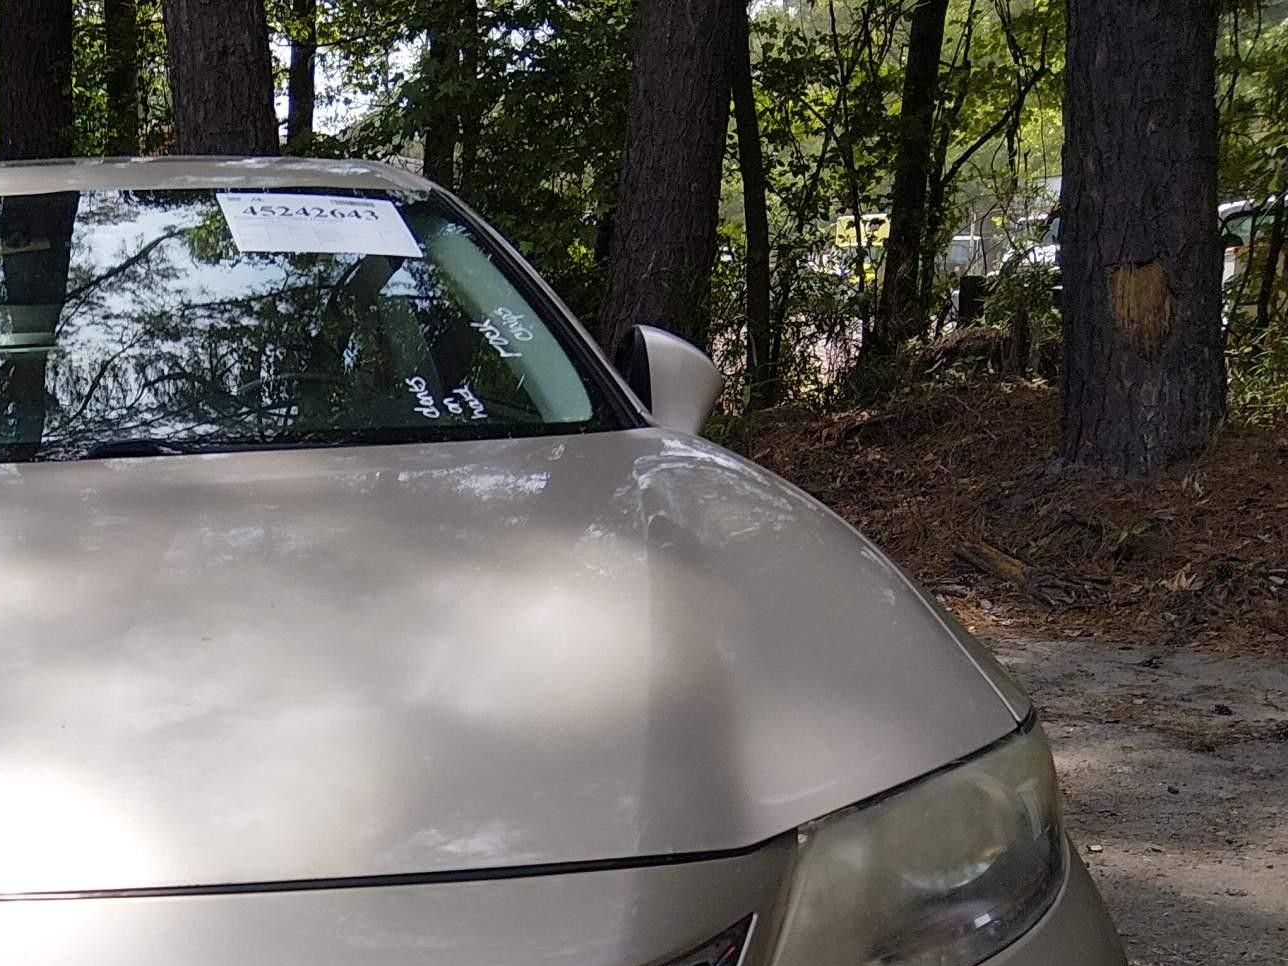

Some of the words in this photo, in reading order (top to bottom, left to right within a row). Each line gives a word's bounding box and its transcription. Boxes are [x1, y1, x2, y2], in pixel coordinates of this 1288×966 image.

[242, 205, 379, 222] 45242643
[405, 376, 440, 418] dents
[443, 397, 463, 414] on
